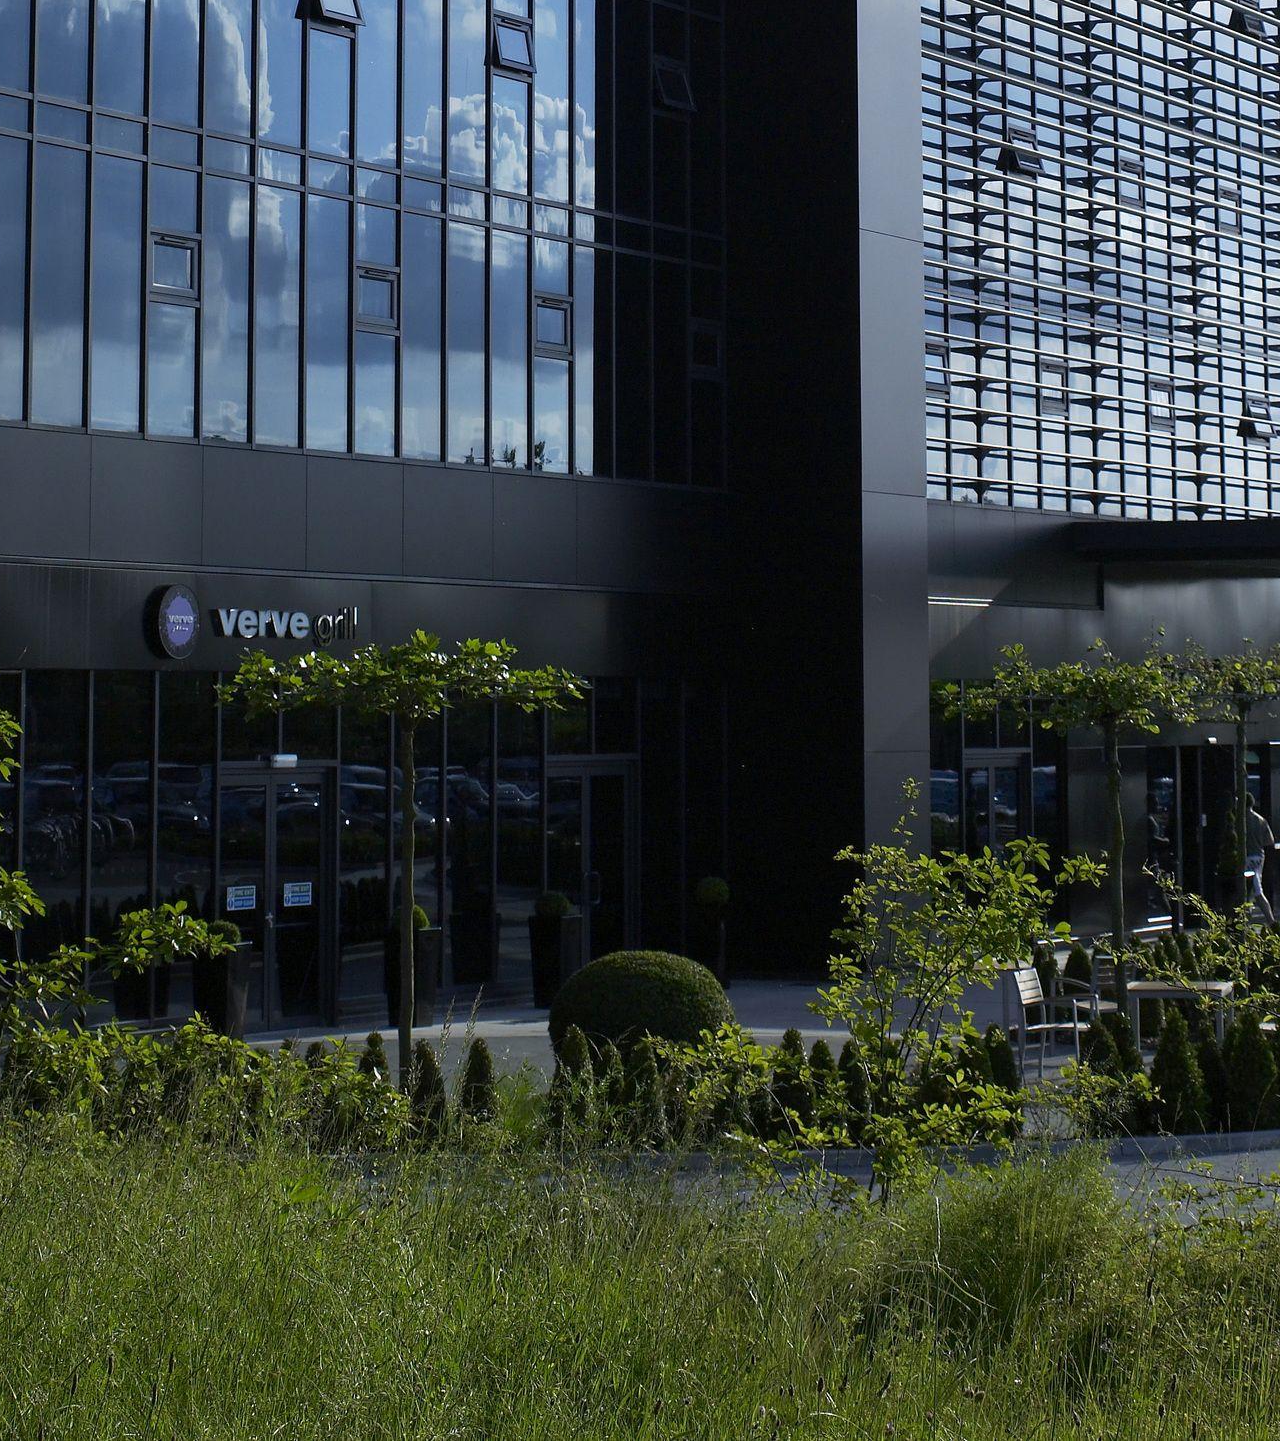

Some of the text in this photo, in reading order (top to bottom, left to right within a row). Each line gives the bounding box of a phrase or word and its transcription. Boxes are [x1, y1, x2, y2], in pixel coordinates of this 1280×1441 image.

[168, 615, 194, 624] verve
[218, 607, 358, 646] verve grill
